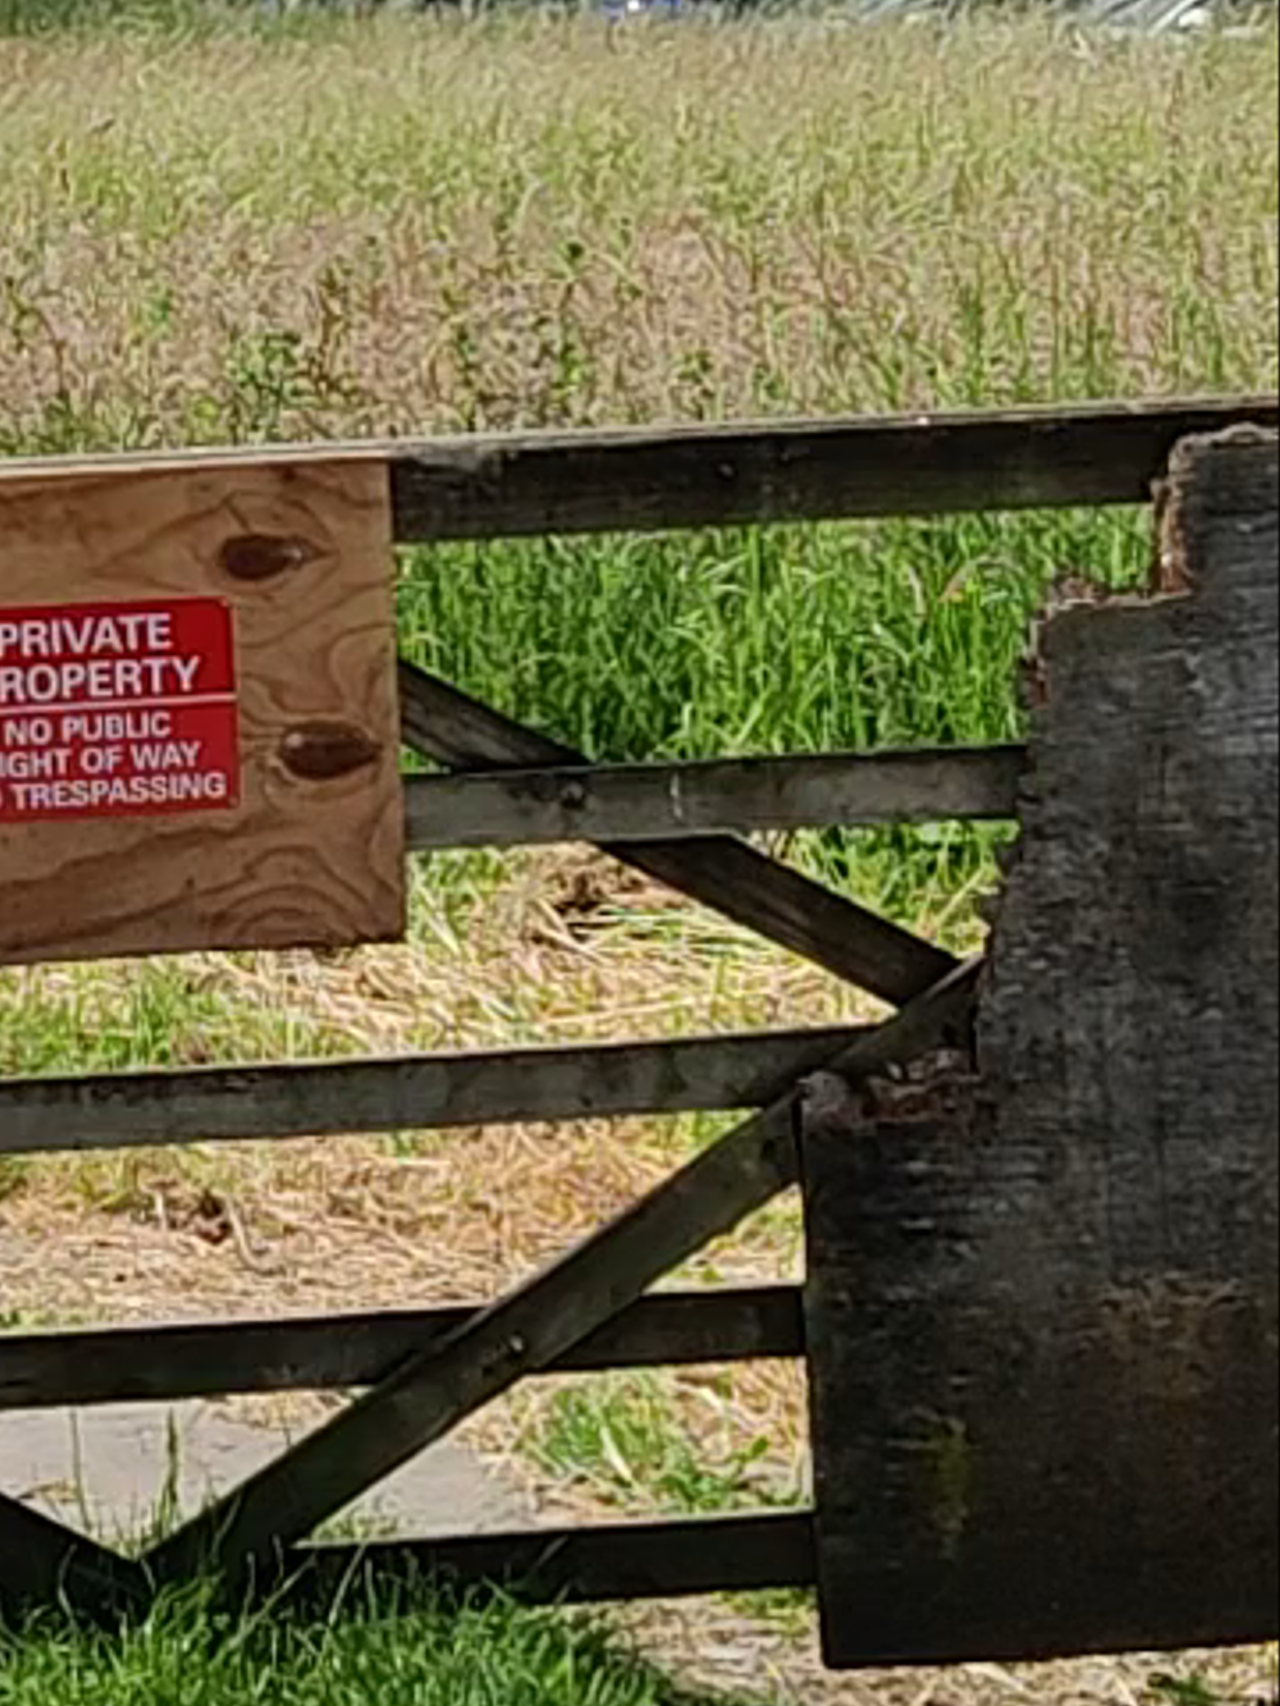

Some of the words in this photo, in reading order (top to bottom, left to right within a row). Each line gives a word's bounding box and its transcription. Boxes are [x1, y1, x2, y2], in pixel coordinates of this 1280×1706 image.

[4, 719, 51, 746] NO
[61, 712, 171, 743] PUBLIC
[80, 747, 124, 773] OF
[130, 741, 201, 771] WAY
[10, 772, 226, 810] TRESPASSING
